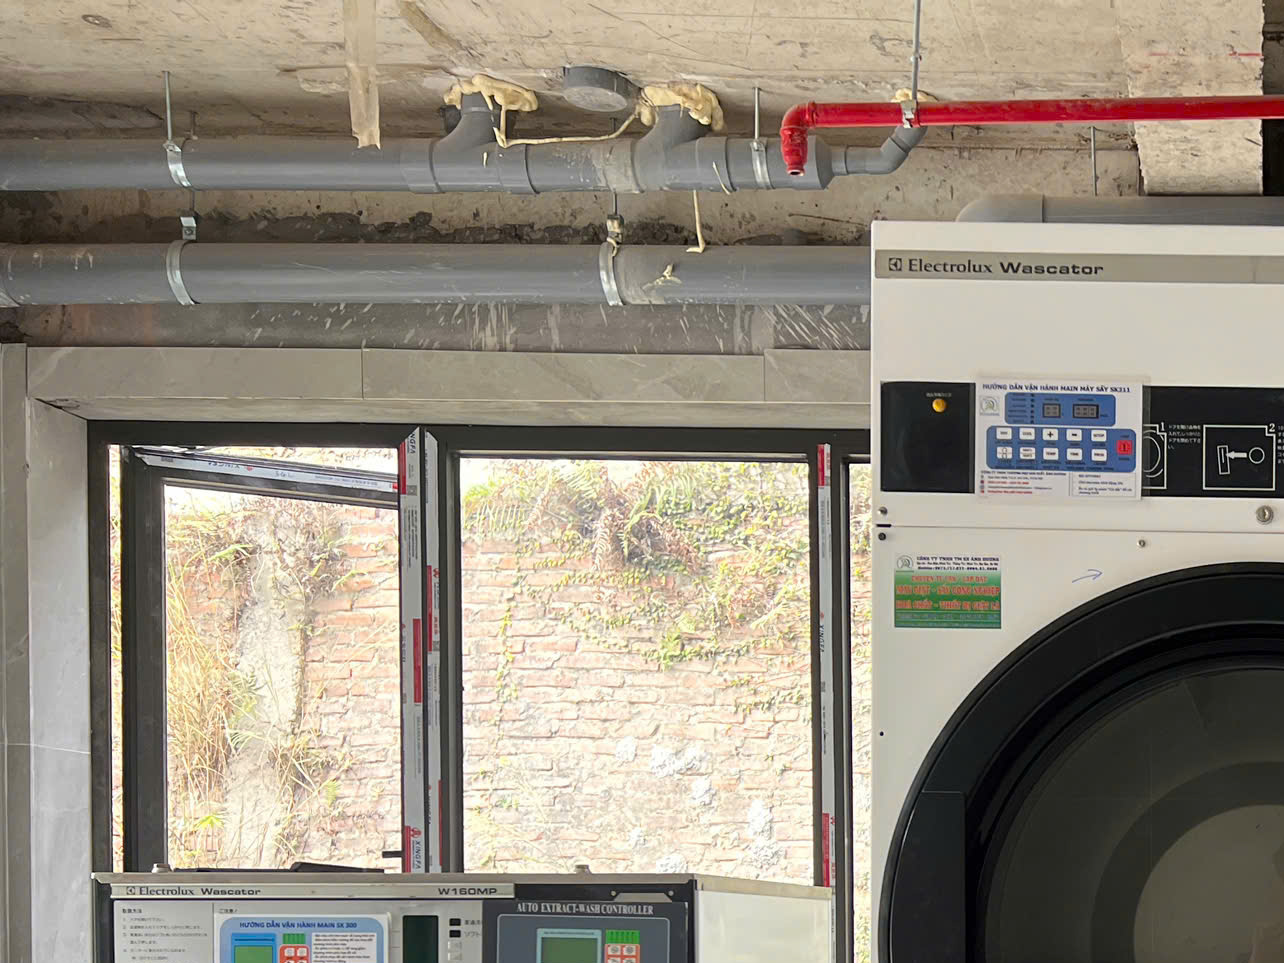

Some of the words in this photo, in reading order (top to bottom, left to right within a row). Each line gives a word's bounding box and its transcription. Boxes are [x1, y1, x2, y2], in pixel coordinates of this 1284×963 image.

[908, 259, 993, 273] Electrolux
[1000, 261, 1104, 275] Wascator
[1161, 422, 1165, 431] 1
[1268, 423, 1275, 432] 2
[139, 886, 195, 895] Electrolux
[200, 887, 261, 895] Wascator
[438, 887, 497, 895] W160MP
[517, 902, 538, 912] AUTO
[541, 903, 600, 914] EXTRACT-WASH
[601, 904, 653, 915] CONTROLLER
[282, 921, 295, 929] VẬN
[297, 920, 315, 928] HÀNH
